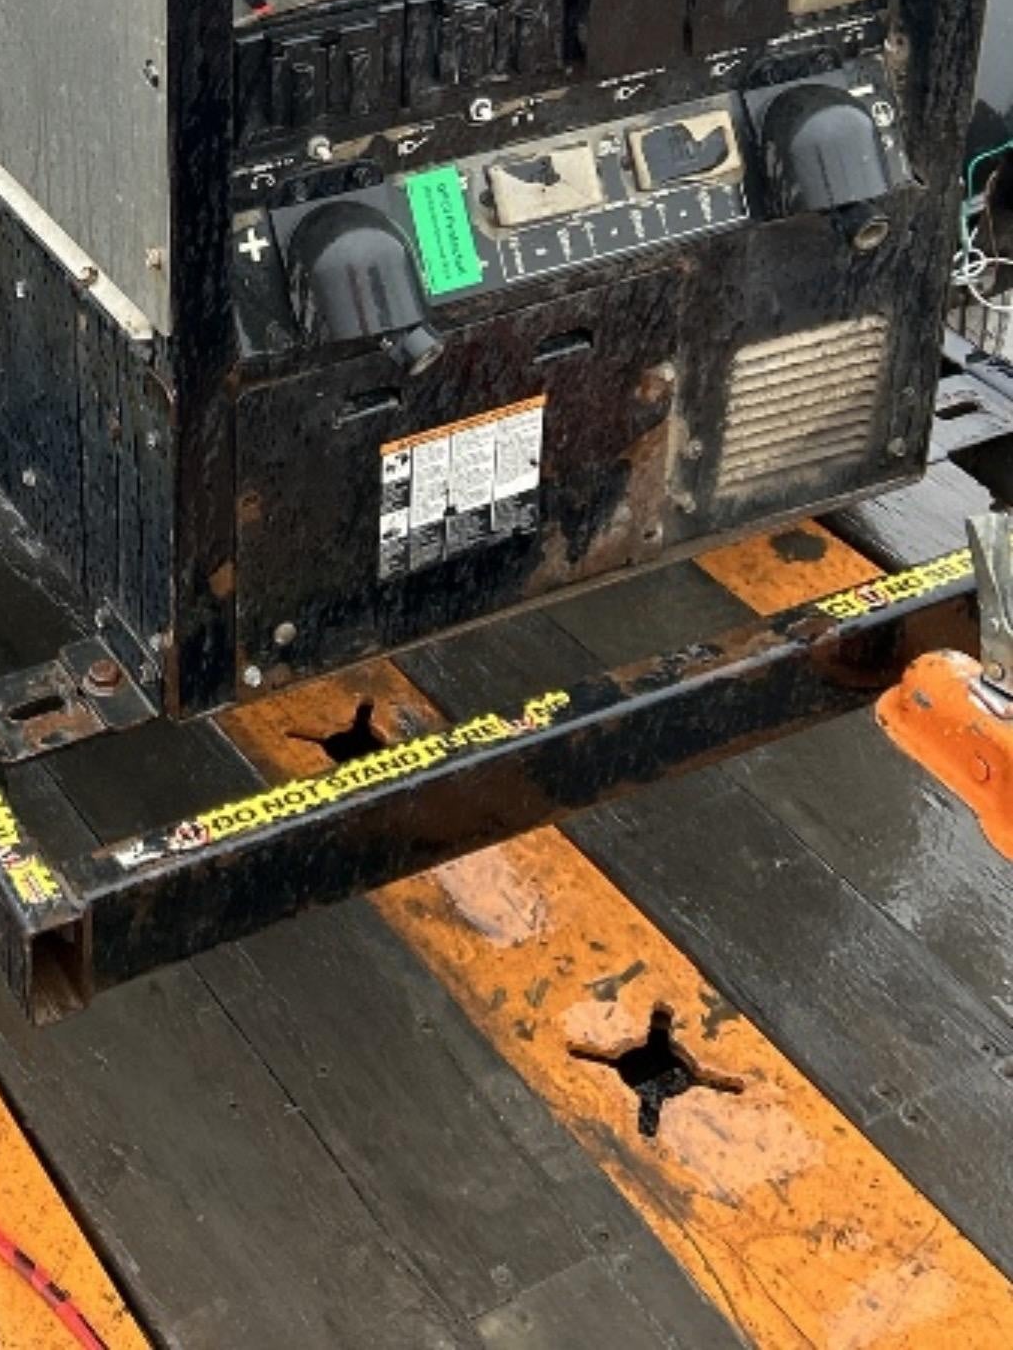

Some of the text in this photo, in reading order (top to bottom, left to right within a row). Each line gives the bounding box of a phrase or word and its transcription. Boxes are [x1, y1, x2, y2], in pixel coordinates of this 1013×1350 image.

[212, 806, 257, 832] DO
[262, 785, 319, 815] NOT
[326, 751, 422, 790] STAND
